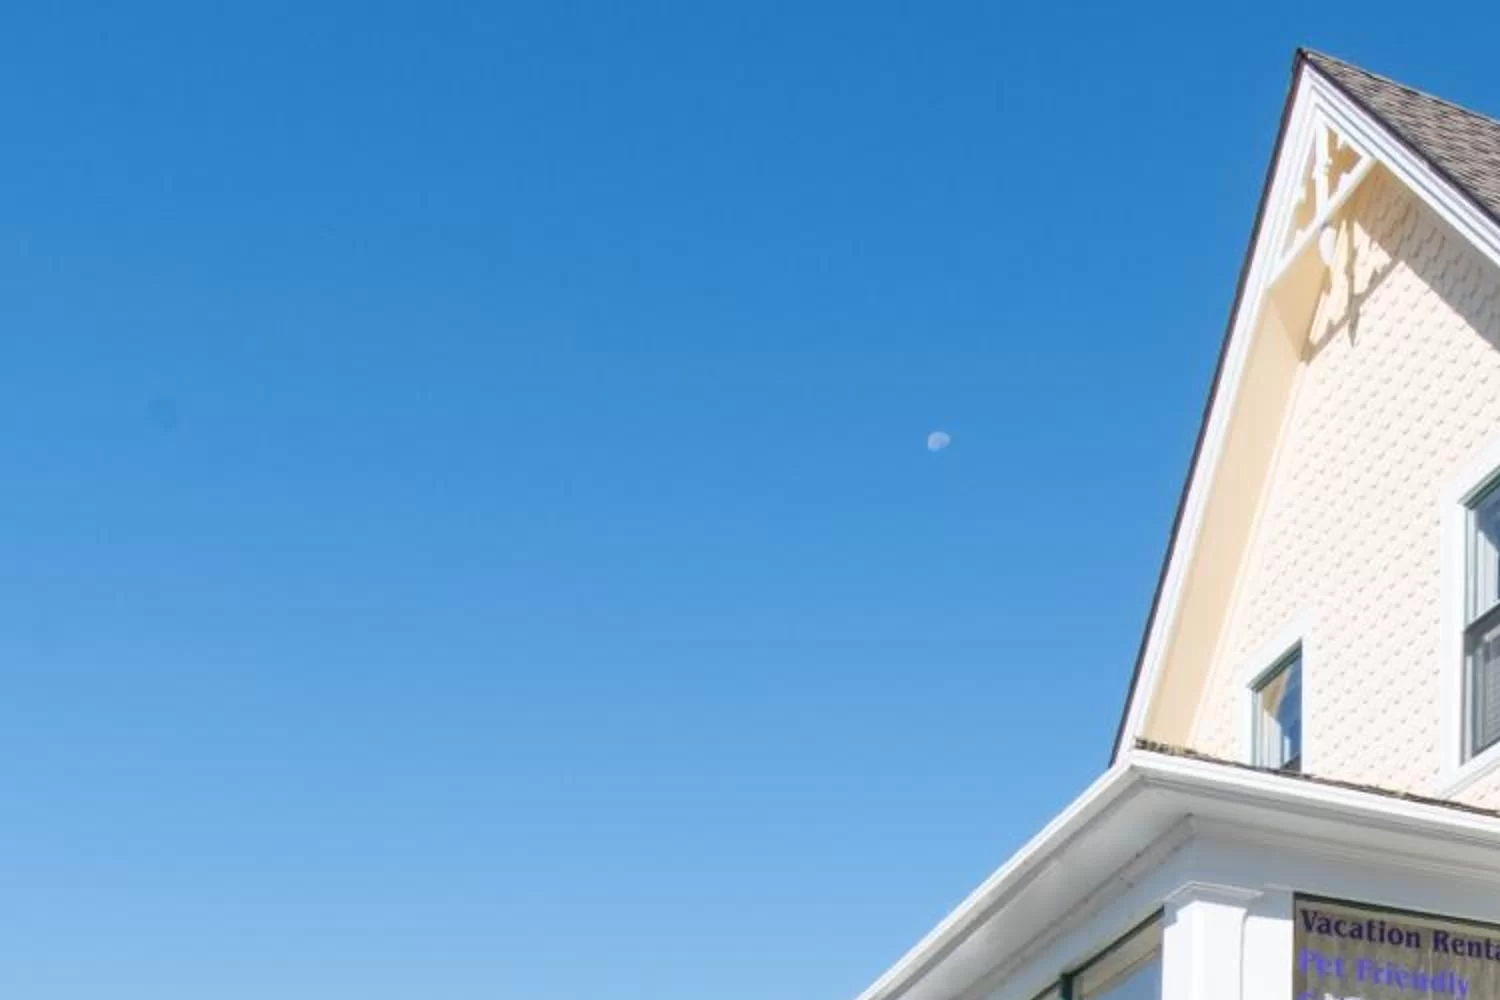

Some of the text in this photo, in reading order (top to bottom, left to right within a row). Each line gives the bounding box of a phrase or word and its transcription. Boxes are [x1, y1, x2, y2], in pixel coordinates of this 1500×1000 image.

[1299, 908, 1421, 949] Vacation
[1297, 947, 1470, 1000] Pet Friendly
